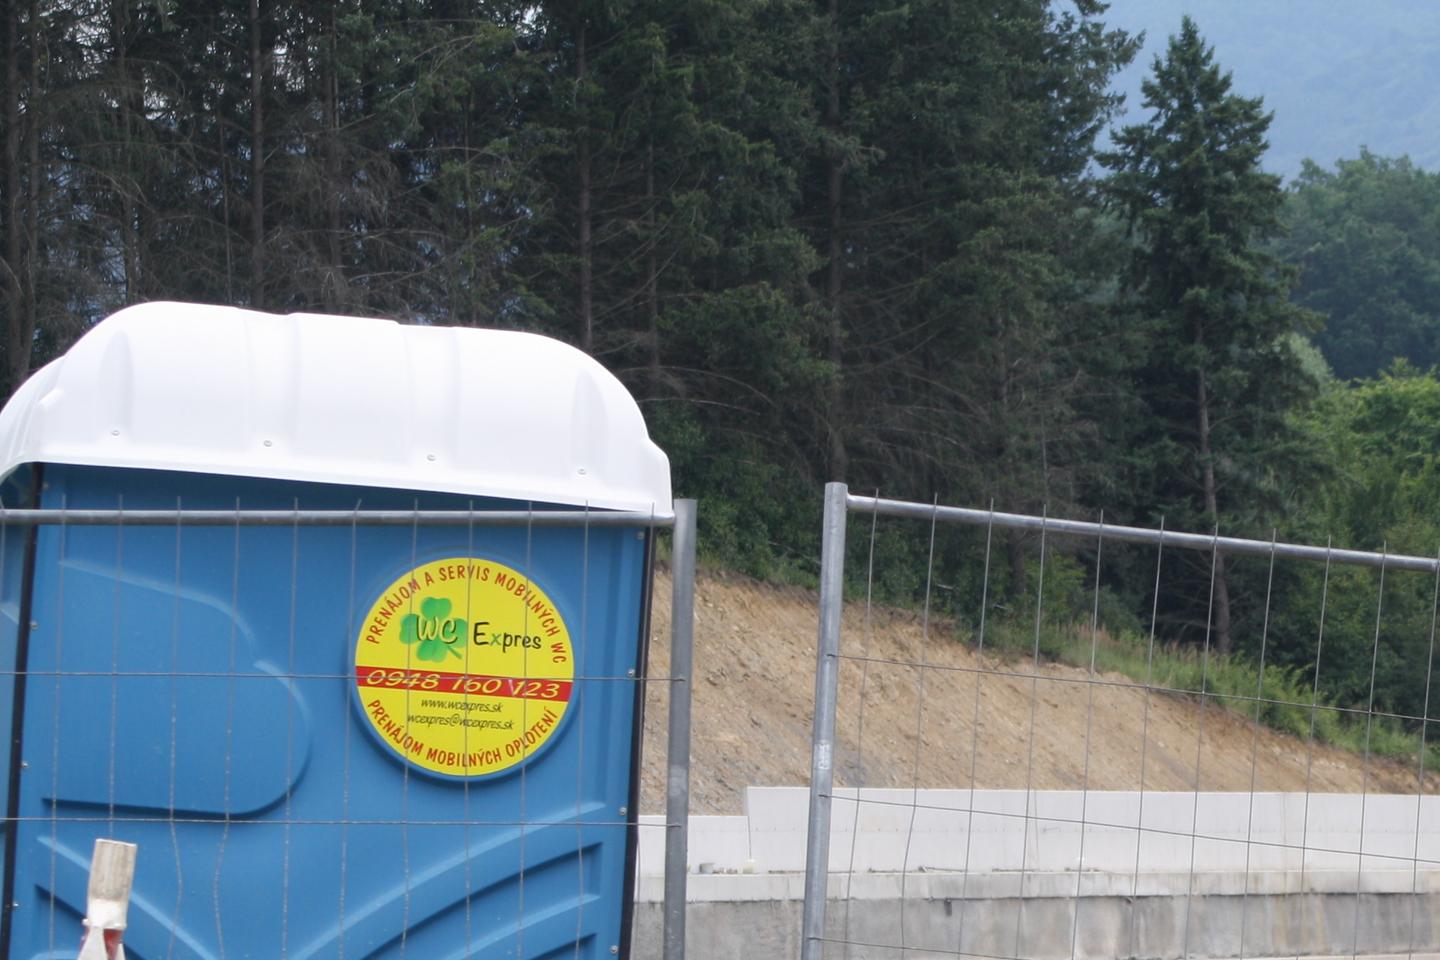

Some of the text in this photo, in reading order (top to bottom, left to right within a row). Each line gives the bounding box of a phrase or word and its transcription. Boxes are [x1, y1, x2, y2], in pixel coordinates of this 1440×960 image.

[366, 564, 567, 664] PRENÁJOM A SERVIS MOBILNÝCH WC
[473, 621, 542, 653] Expres
[366, 669, 560, 698] 0948 160 123
[420, 699, 503, 713] www.wcexpres.sk
[367, 698, 559, 768] PRENÁJOM MOBILNÝCH OPLOTENÍ
[407, 713, 514, 731] wcexpres@wcexpres.sk
